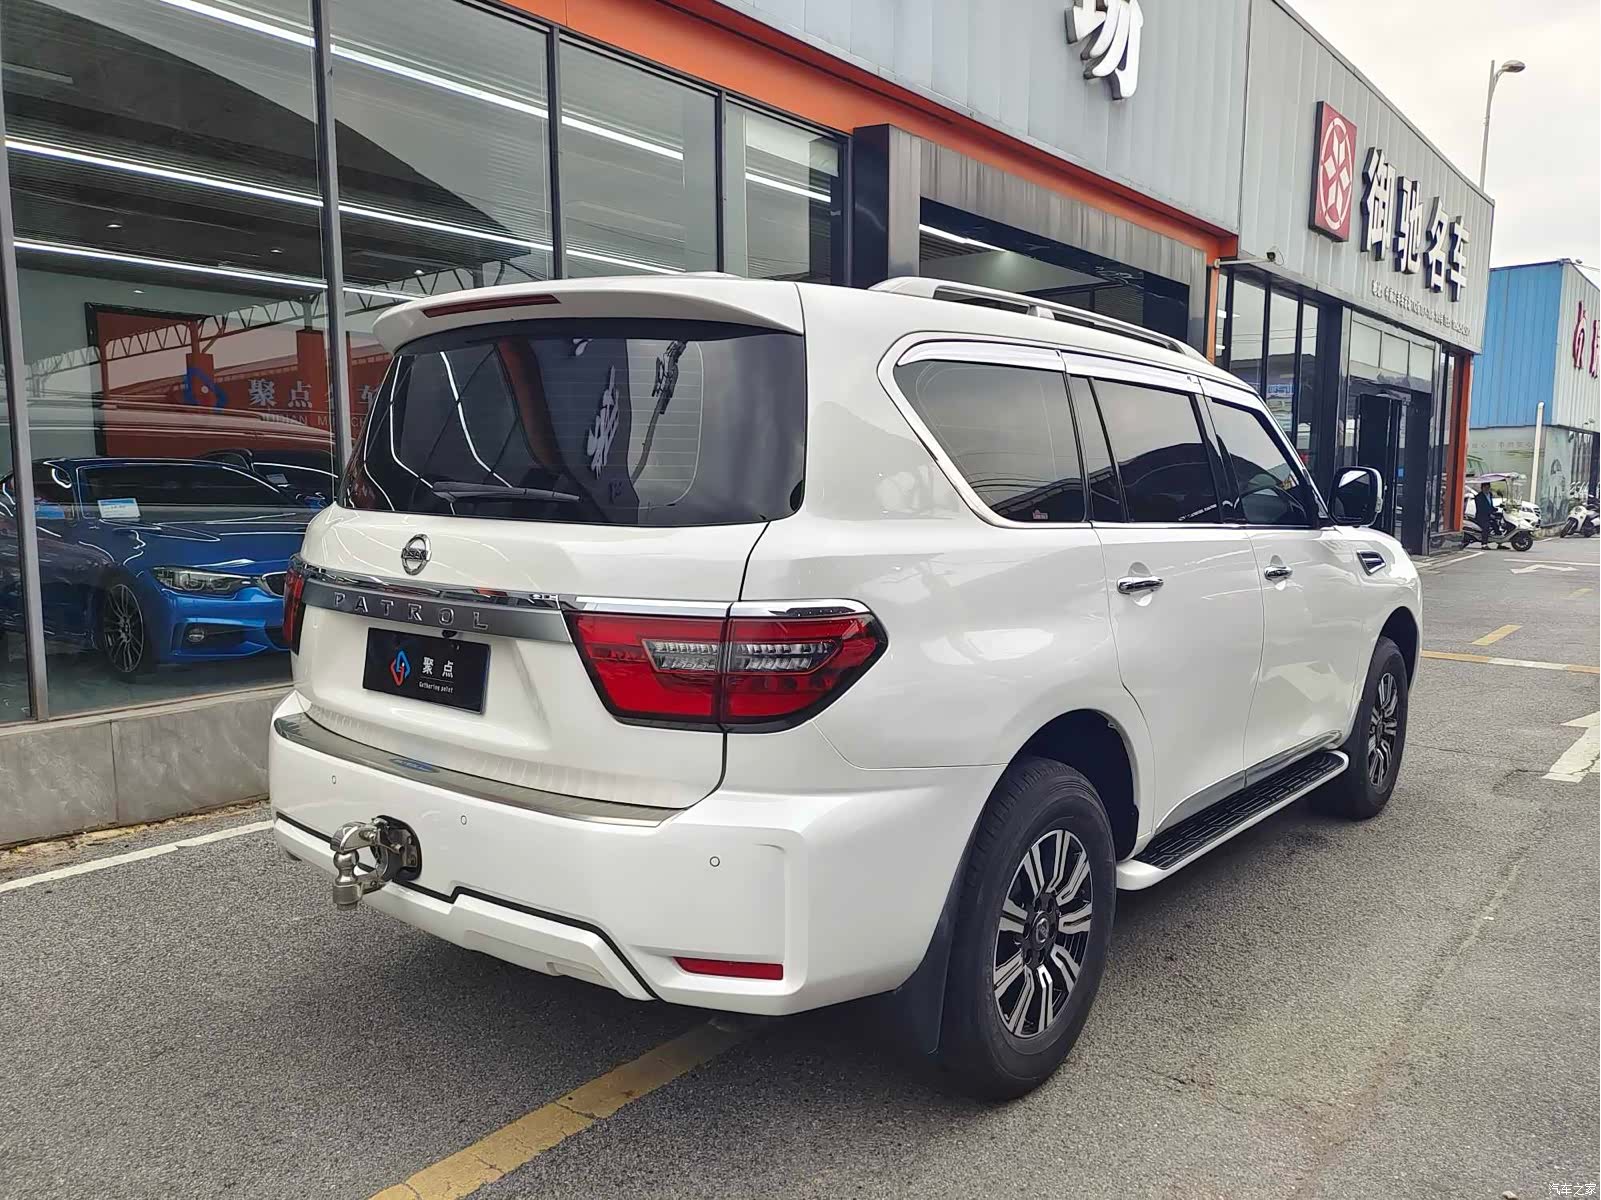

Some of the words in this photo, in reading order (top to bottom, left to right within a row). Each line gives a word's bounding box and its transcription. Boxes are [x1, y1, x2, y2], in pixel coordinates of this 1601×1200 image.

[1361, 146, 1470, 302] 御驰名车
[333, 592, 489, 630] PATROL
[422, 656, 454, 678] 聚点
[418, 681, 440, 692] Gathering
